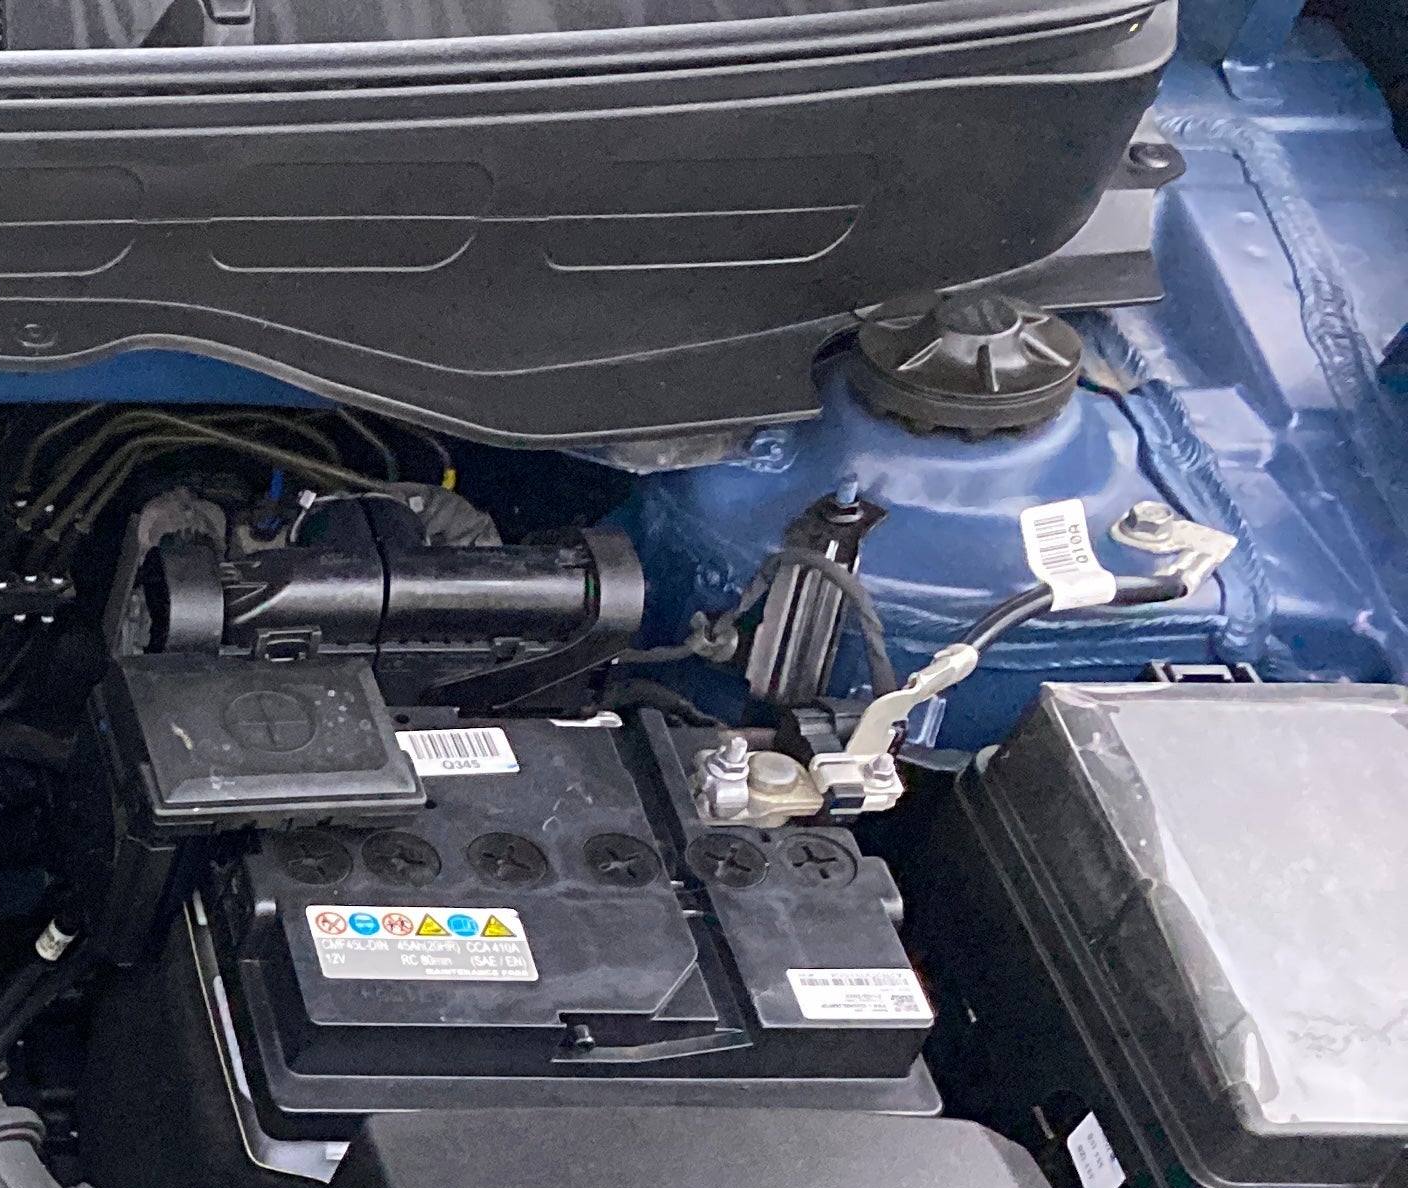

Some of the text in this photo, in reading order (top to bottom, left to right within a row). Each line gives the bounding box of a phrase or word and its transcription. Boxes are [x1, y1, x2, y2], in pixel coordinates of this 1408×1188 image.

[1068, 523, 1089, 564] Q10A
[442, 759, 481, 770] Q345
[325, 953, 346, 965] 12V
[400, 954, 419, 966] RC
